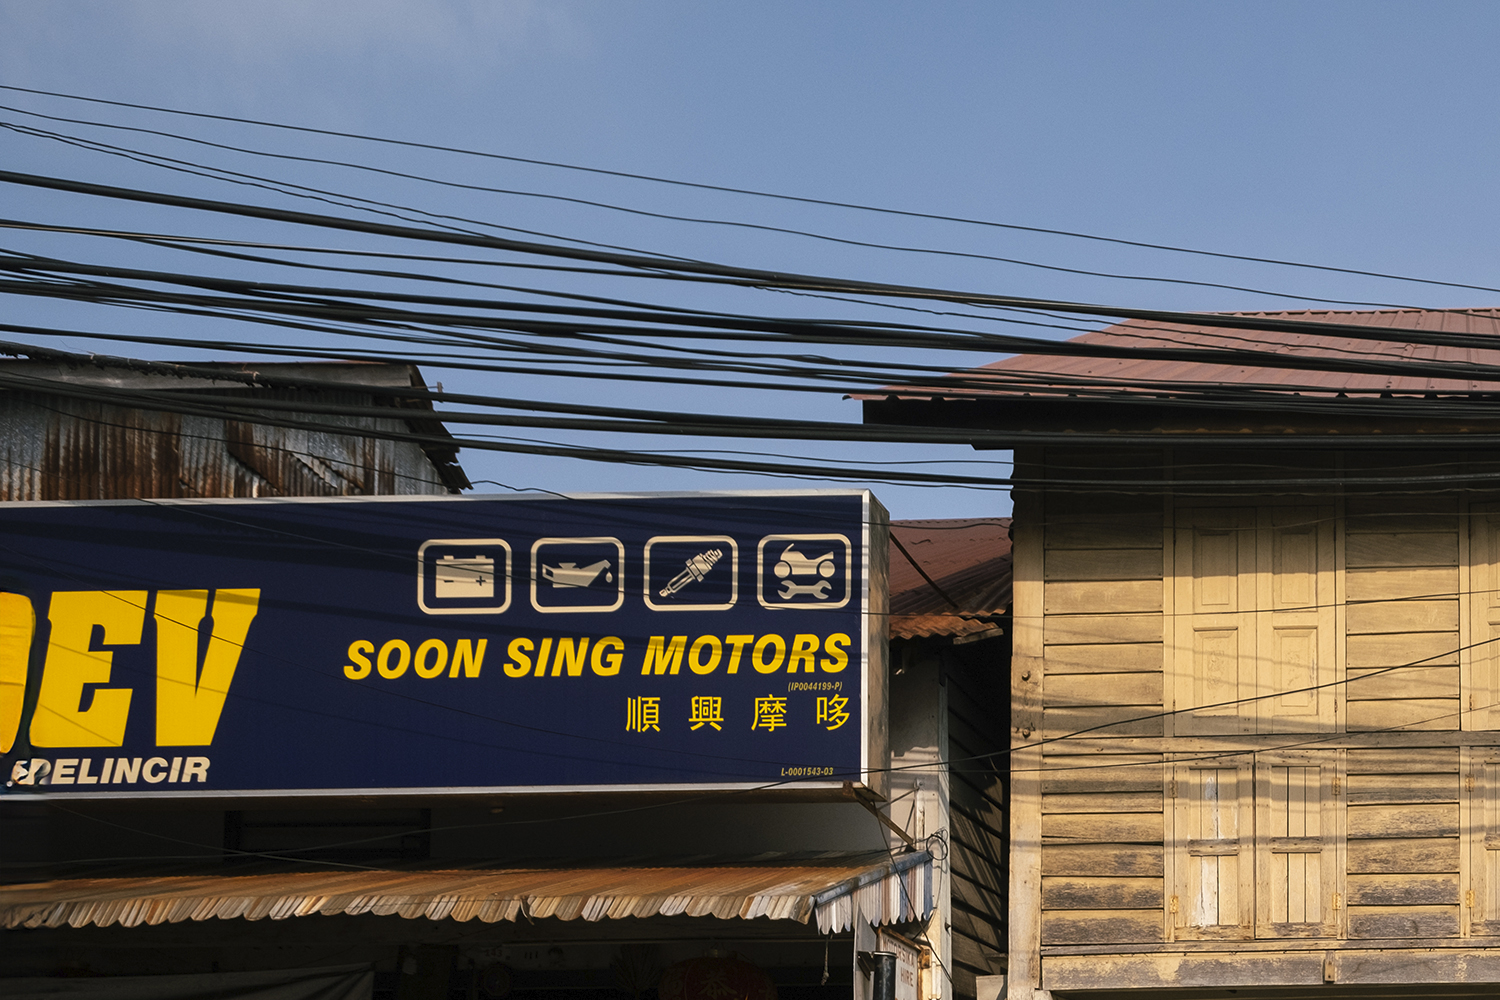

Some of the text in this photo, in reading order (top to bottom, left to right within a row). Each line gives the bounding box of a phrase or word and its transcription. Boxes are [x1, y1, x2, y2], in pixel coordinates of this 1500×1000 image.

[343, 632, 851, 680] SOON SING MOTORS
[787, 681, 843, 692] (IP0044199-P)
[781, 767, 834, 776] L-0001543-03
